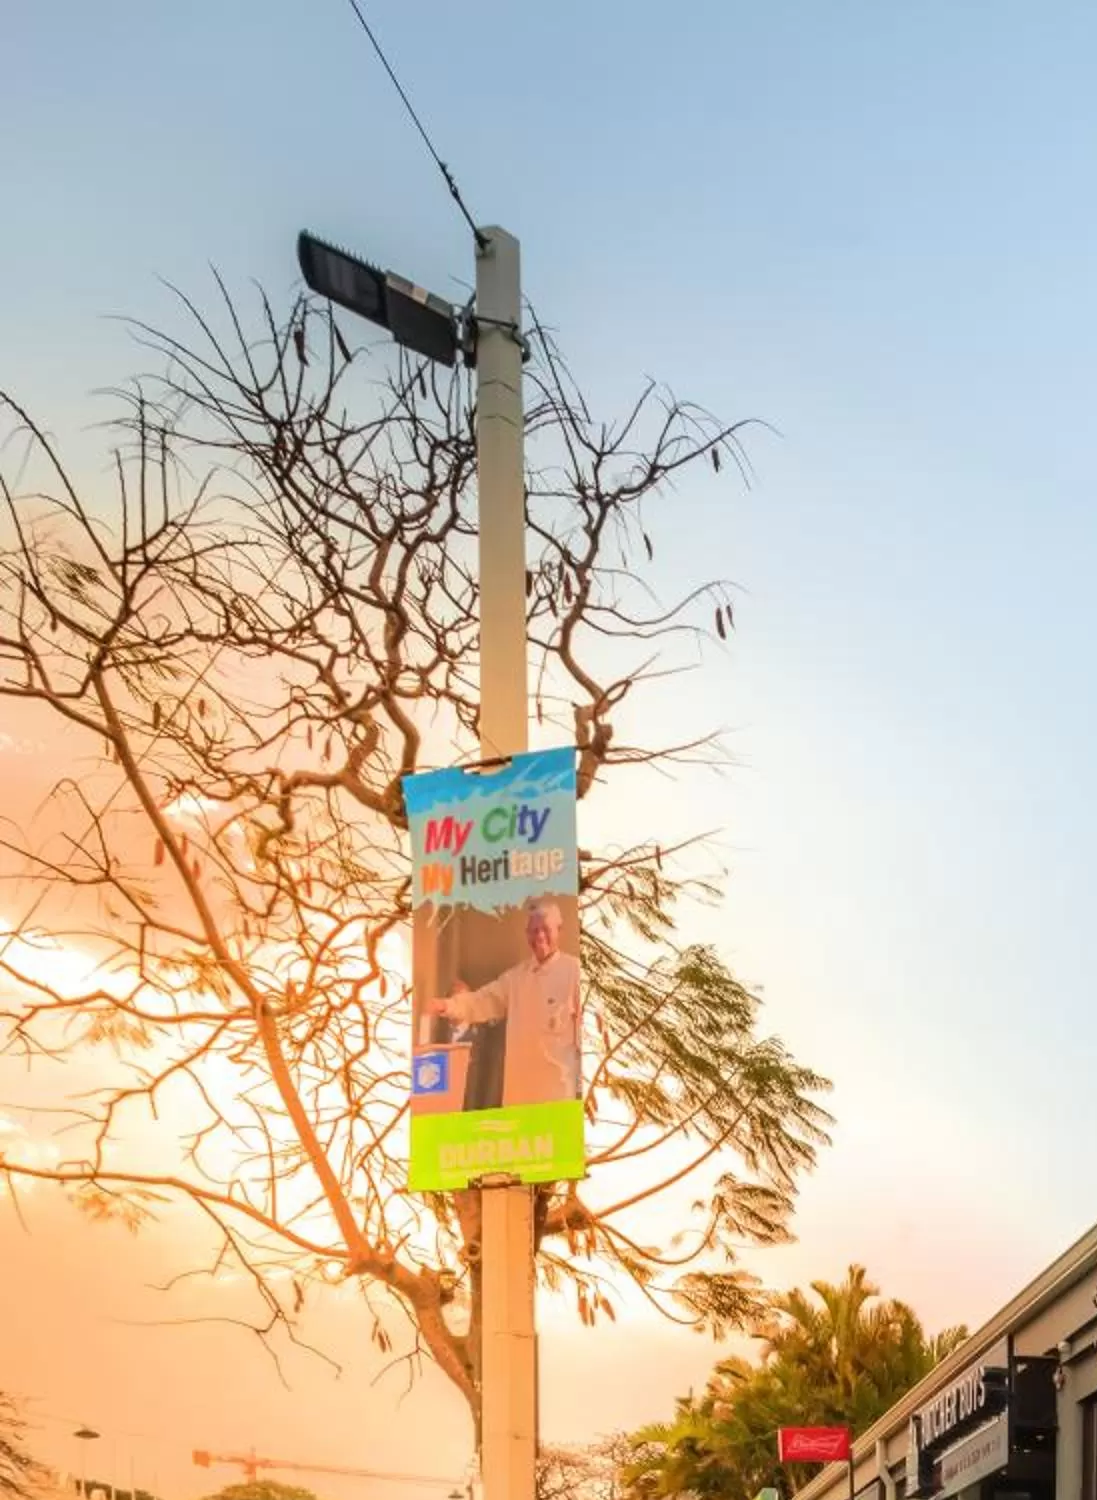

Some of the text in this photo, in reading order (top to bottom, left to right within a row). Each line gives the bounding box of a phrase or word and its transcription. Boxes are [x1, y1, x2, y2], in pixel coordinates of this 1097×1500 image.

[424, 803, 551, 856] My City
[460, 848, 564, 886] Heritage
